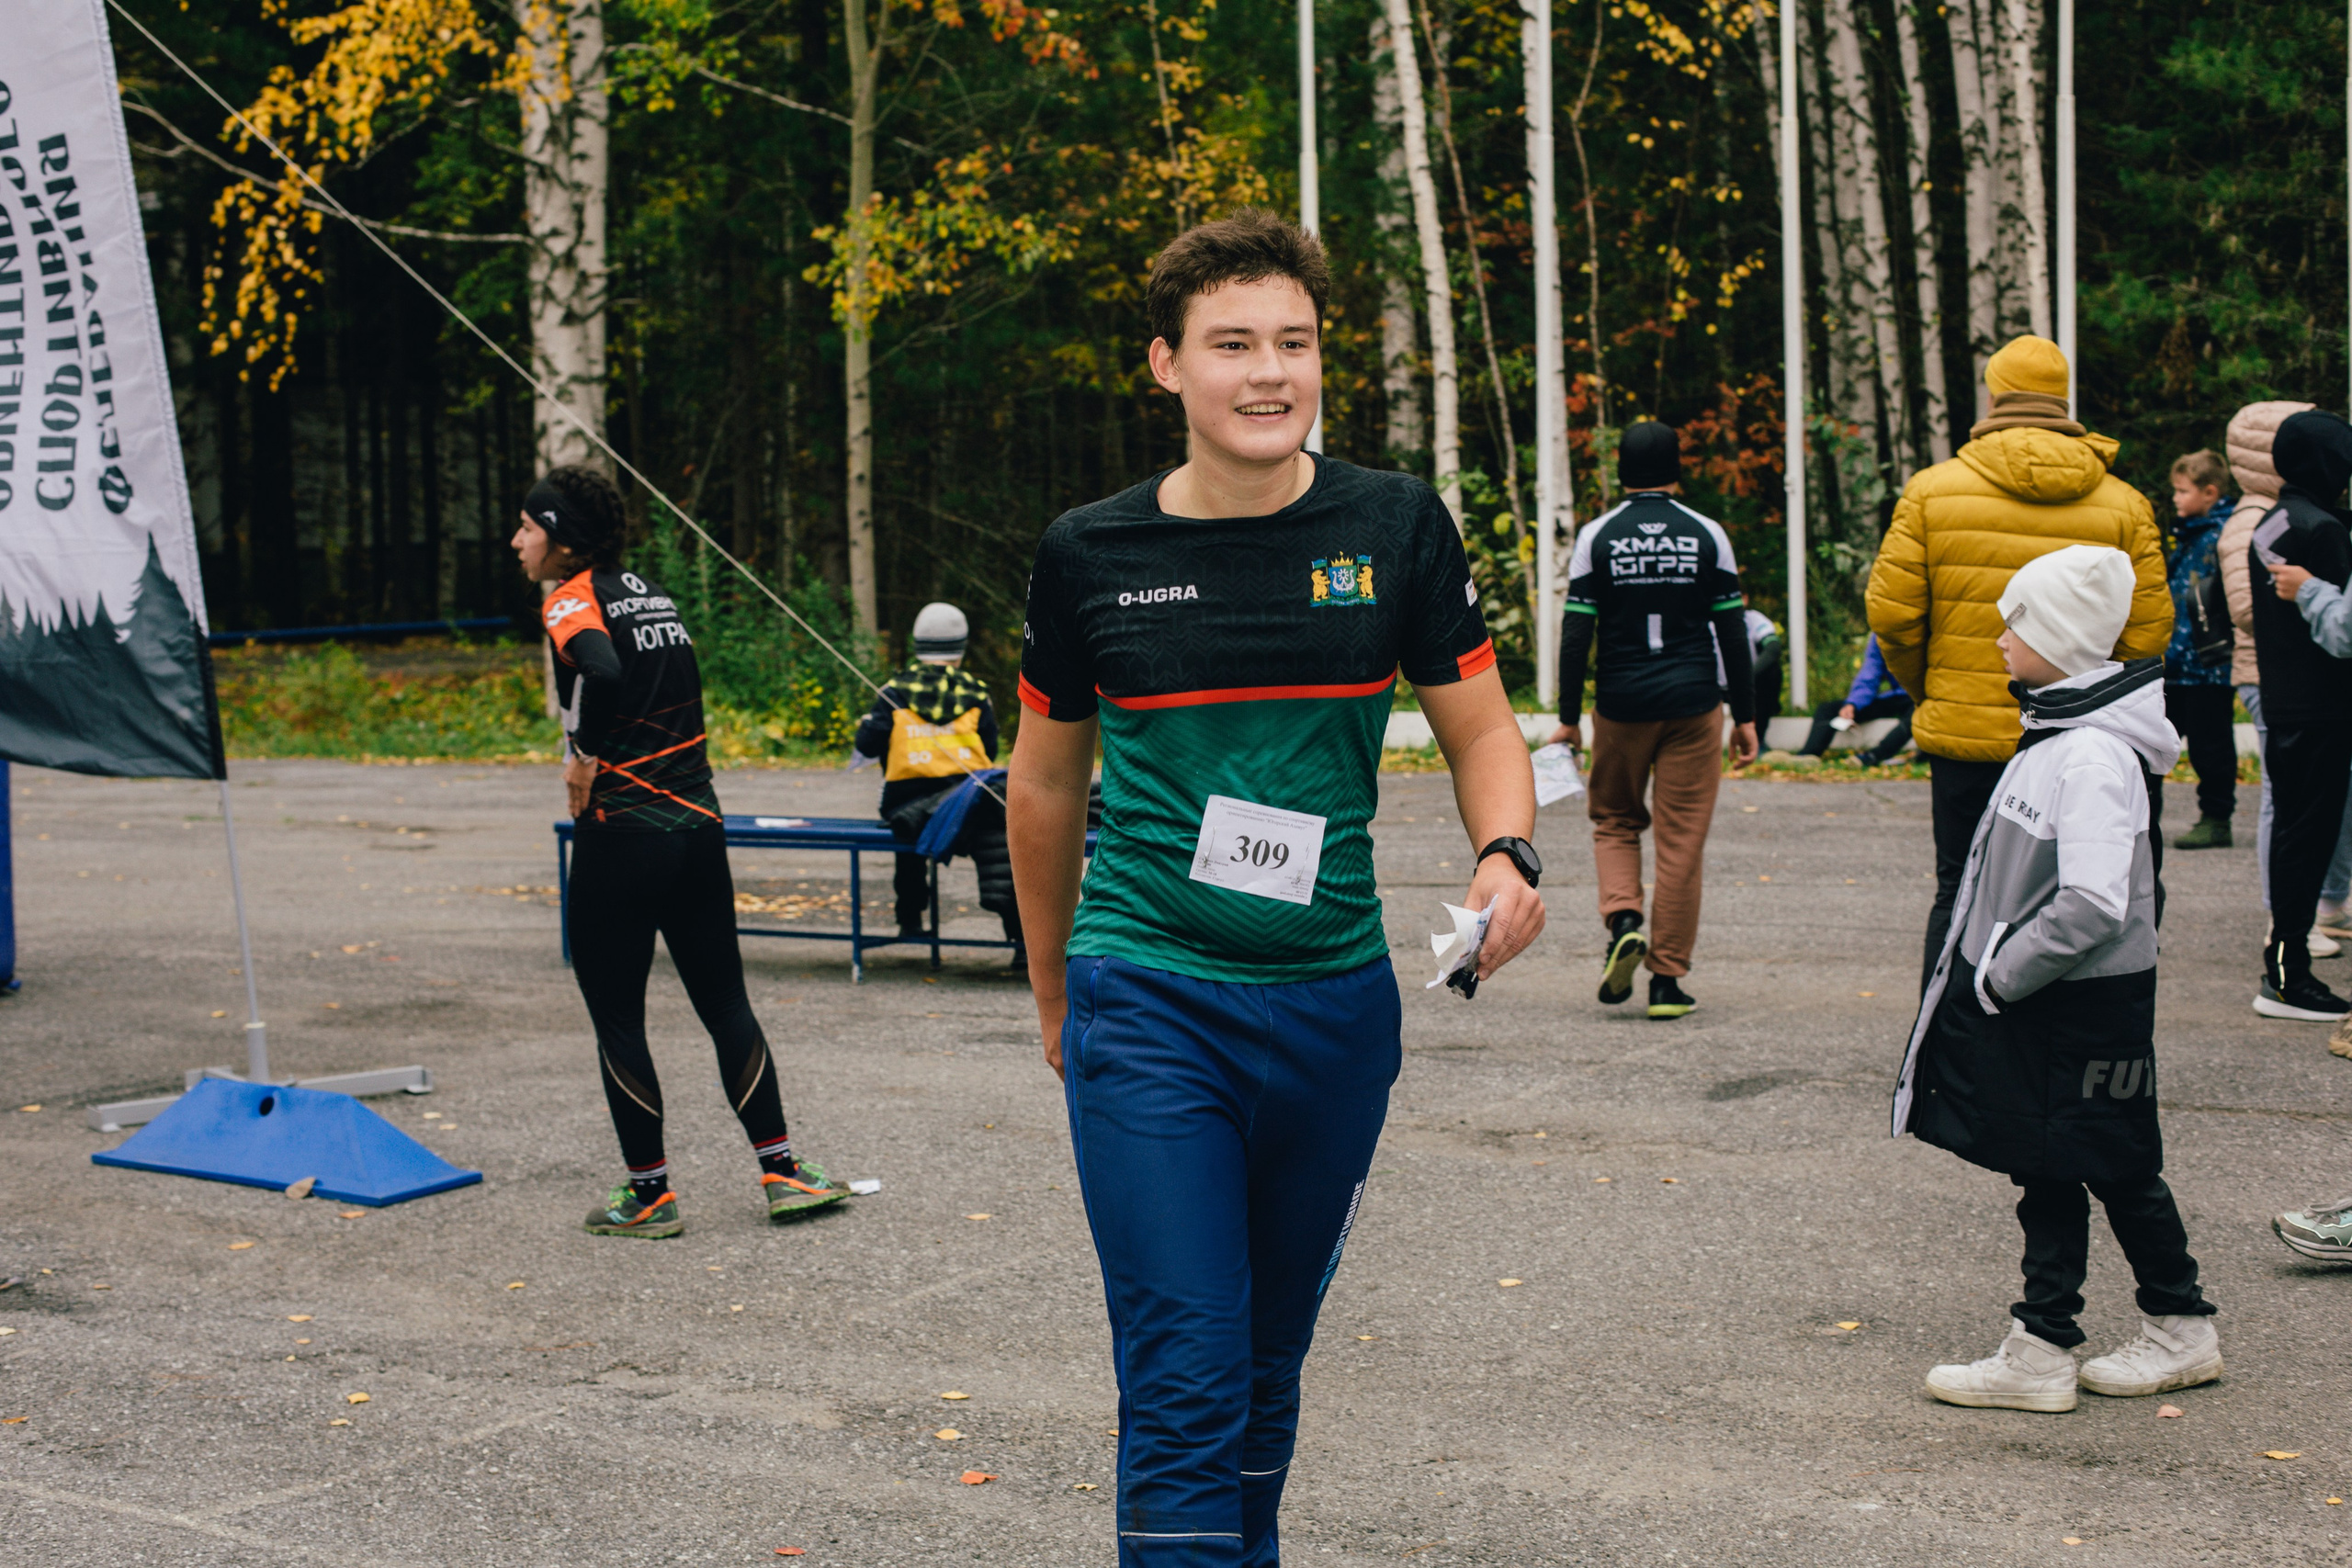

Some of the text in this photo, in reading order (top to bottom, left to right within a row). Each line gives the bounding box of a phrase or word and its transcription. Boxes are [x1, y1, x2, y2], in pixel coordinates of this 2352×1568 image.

[1610, 556, 1699, 577] ЮГРА
[1118, 584, 1198, 606] O-UGRA
[632, 622, 693, 652] ЮГРА
[1229, 835, 1290, 870] 309
